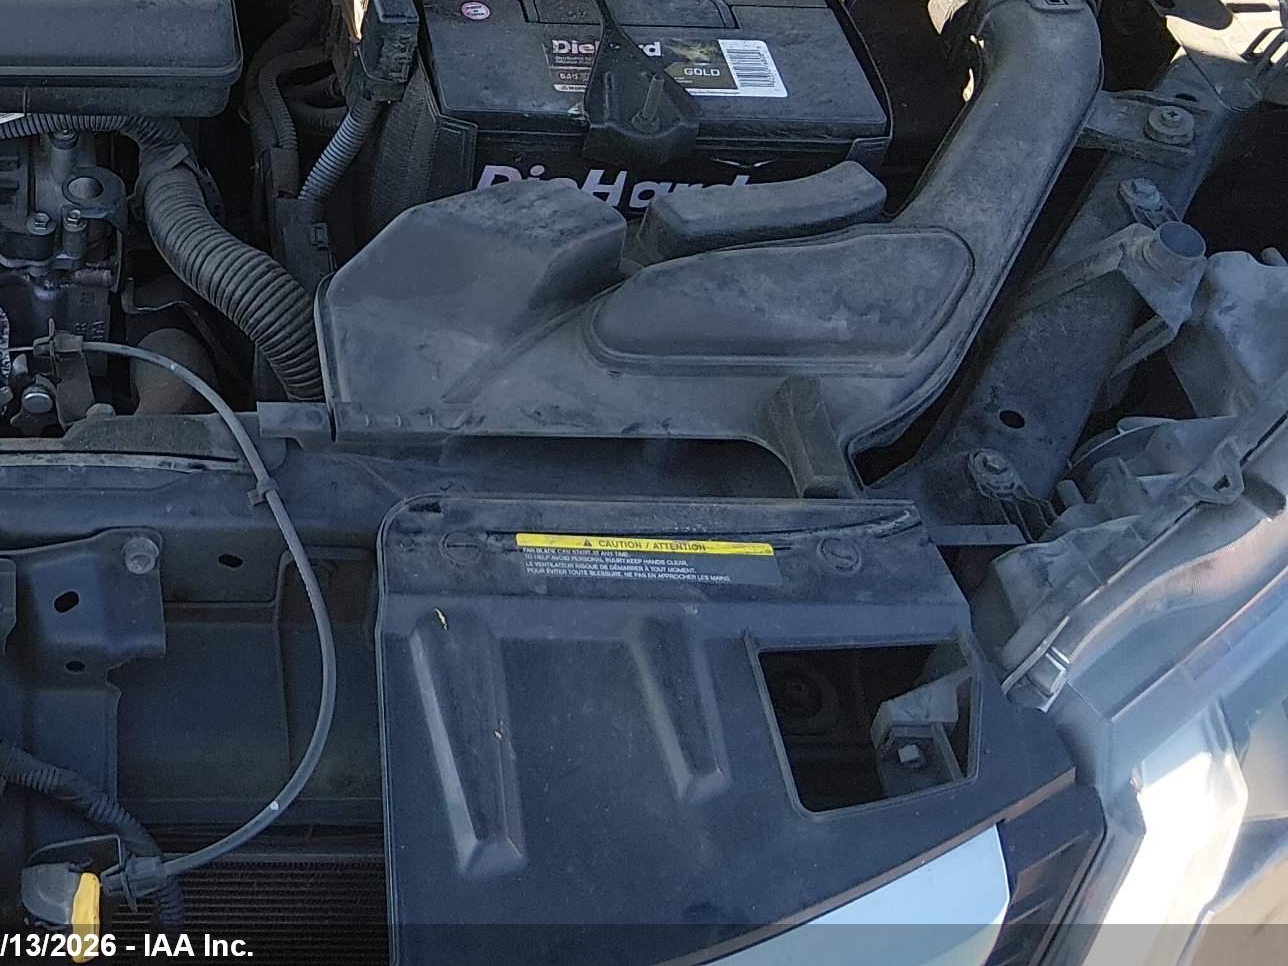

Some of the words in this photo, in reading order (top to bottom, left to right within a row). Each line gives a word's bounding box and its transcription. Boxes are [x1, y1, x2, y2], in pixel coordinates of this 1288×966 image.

[684, 68, 720, 76] GOLD
[598, 540, 642, 549] CAUTION
[653, 542, 706, 551] ATTENTION
